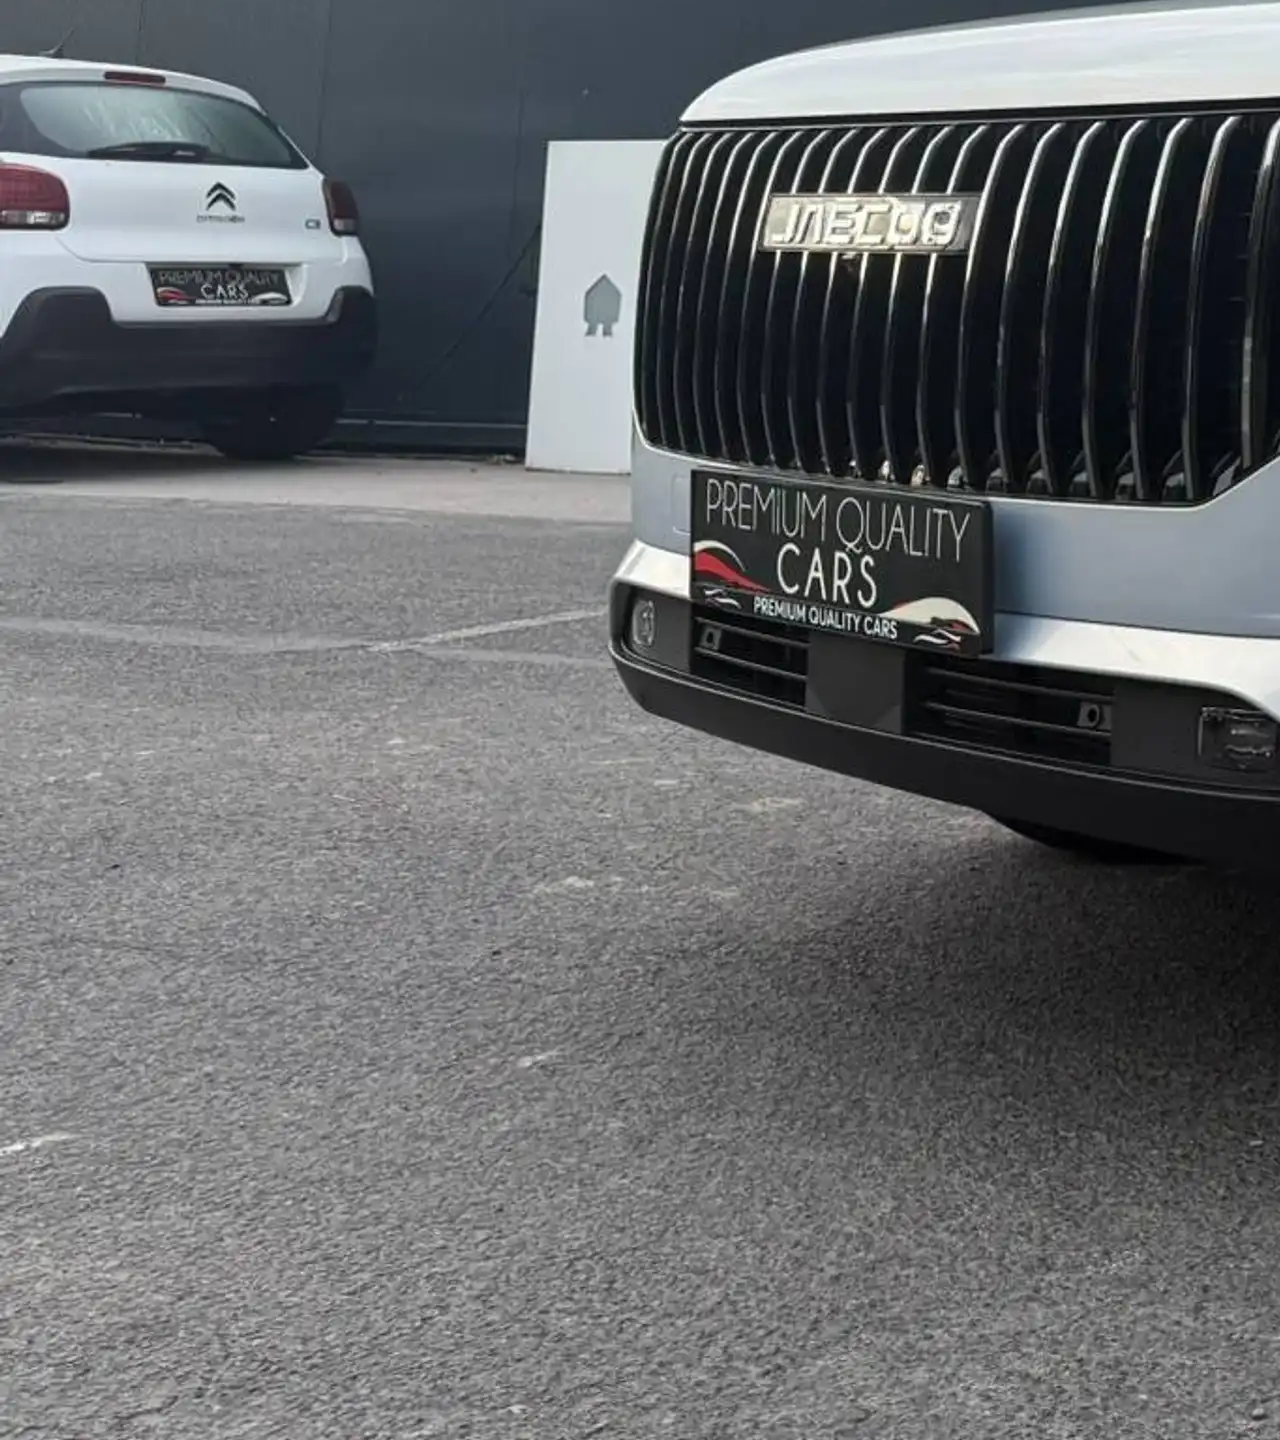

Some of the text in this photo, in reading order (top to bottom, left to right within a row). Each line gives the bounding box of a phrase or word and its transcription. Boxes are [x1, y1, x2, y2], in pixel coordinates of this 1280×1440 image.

[200, 283, 249, 299] CARS
[706, 478, 971, 562] PREMIUM QUALITY
[776, 542, 878, 608] CARS
[753, 595, 898, 640] PREMIUM QUALITY CARS
